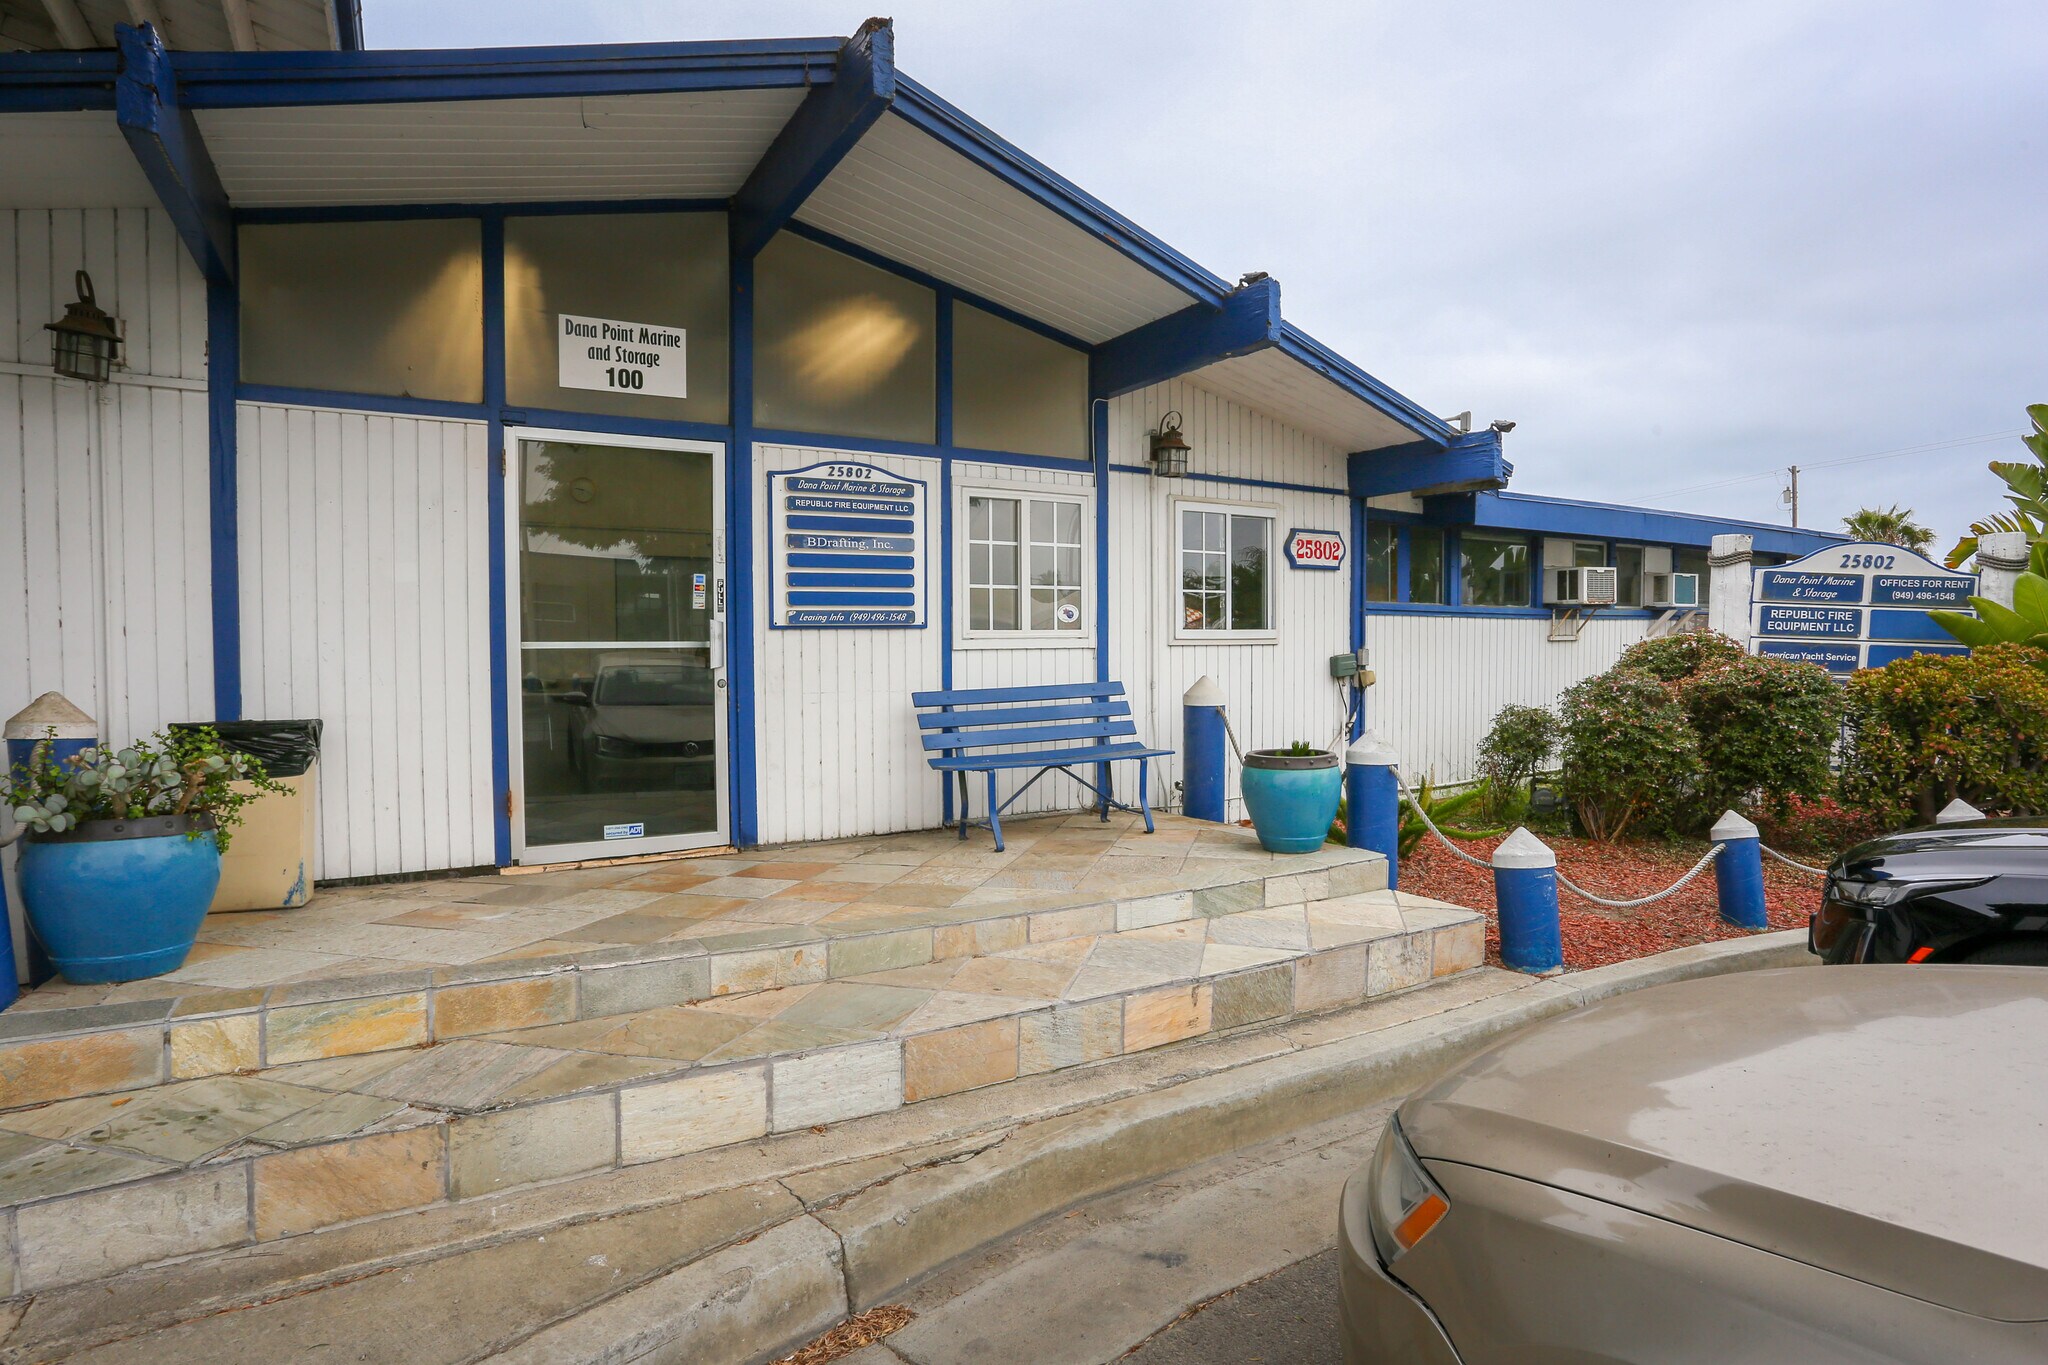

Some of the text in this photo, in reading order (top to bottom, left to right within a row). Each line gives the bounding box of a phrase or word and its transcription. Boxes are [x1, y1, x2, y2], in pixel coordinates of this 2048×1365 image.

[565, 318, 681, 348] Dana Point Marine
[588, 345, 660, 368] and Storage
[606, 367, 644, 390] 100
[828, 466, 872, 479] 25802
[798, 479, 906, 496] Dana Point Marine & Storage
[795, 499, 833, 508] REPUBLIC
[852, 503, 894, 511] EQUIPMENT
[807, 537, 894, 550] BDrafting, Inc.
[1296, 538, 1340, 561] 25802
[1839, 554, 1896, 570] 25802
[1772, 574, 1856, 586] Dana Point Marine
[1879, 579, 1971, 589] OFFICES FOR RENT
[1792, 587, 1838, 600] & Storage
[1892, 590, 1956, 601] (949) 496-1548
[799, 612, 828, 623] Leasing
[829, 613, 845, 622] Info
[1770, 609, 1853, 621] REPUBLIC FIRE
[1767, 621, 1855, 632] EQUIPMENT LLC
[1800, 652, 1824, 661] Yacht
[1825, 652, 1857, 662] Service
[629, 826, 641, 835] ADT
